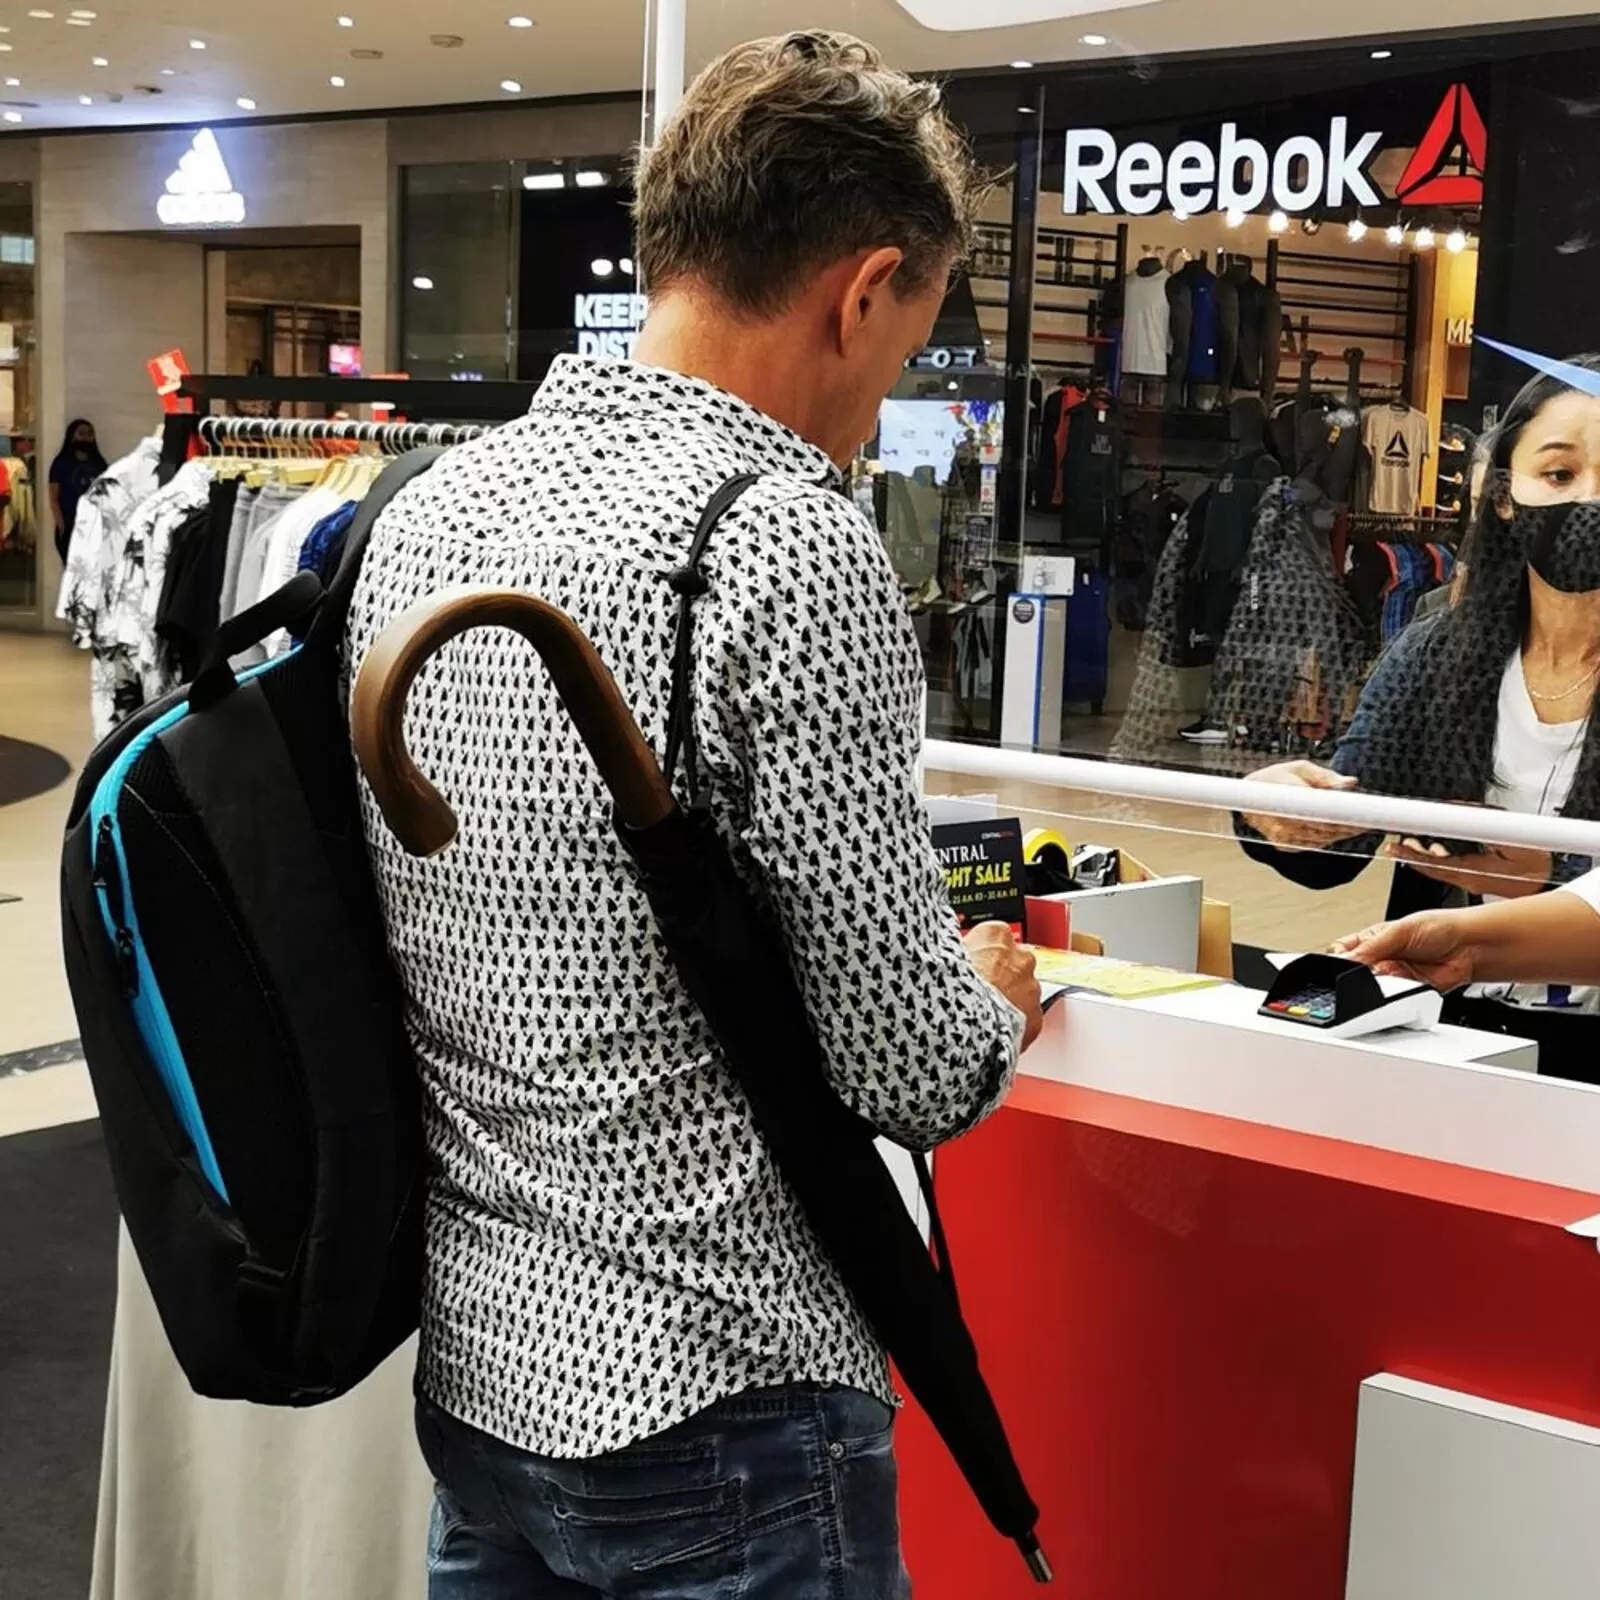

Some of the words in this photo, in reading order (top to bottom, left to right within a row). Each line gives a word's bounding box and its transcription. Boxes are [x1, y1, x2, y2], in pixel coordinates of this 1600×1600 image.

[1062, 116, 1383, 215] Reebok
[574, 293, 649, 328] KEEP
[933, 843, 989, 864] NTRAL
[975, 861, 1012, 886] SALE
